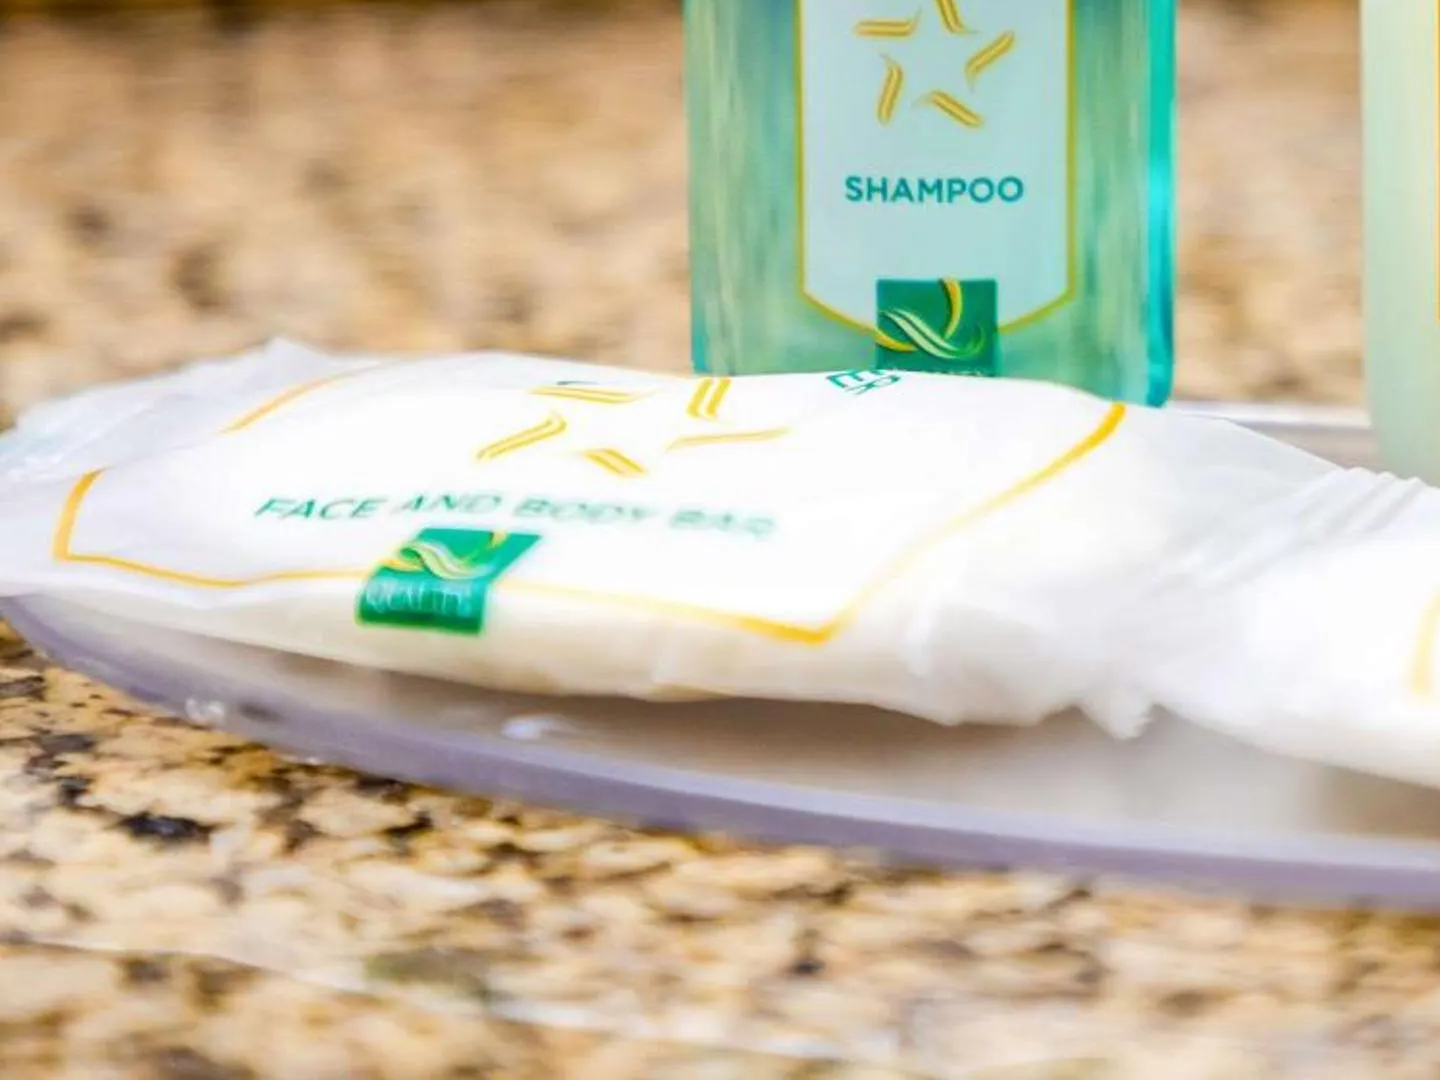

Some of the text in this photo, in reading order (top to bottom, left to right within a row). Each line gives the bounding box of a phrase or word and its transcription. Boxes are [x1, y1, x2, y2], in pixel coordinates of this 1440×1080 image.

[844, 175, 1025, 204] SHAMPOO
[253, 493, 777, 538] FACE AND BODY BAR
